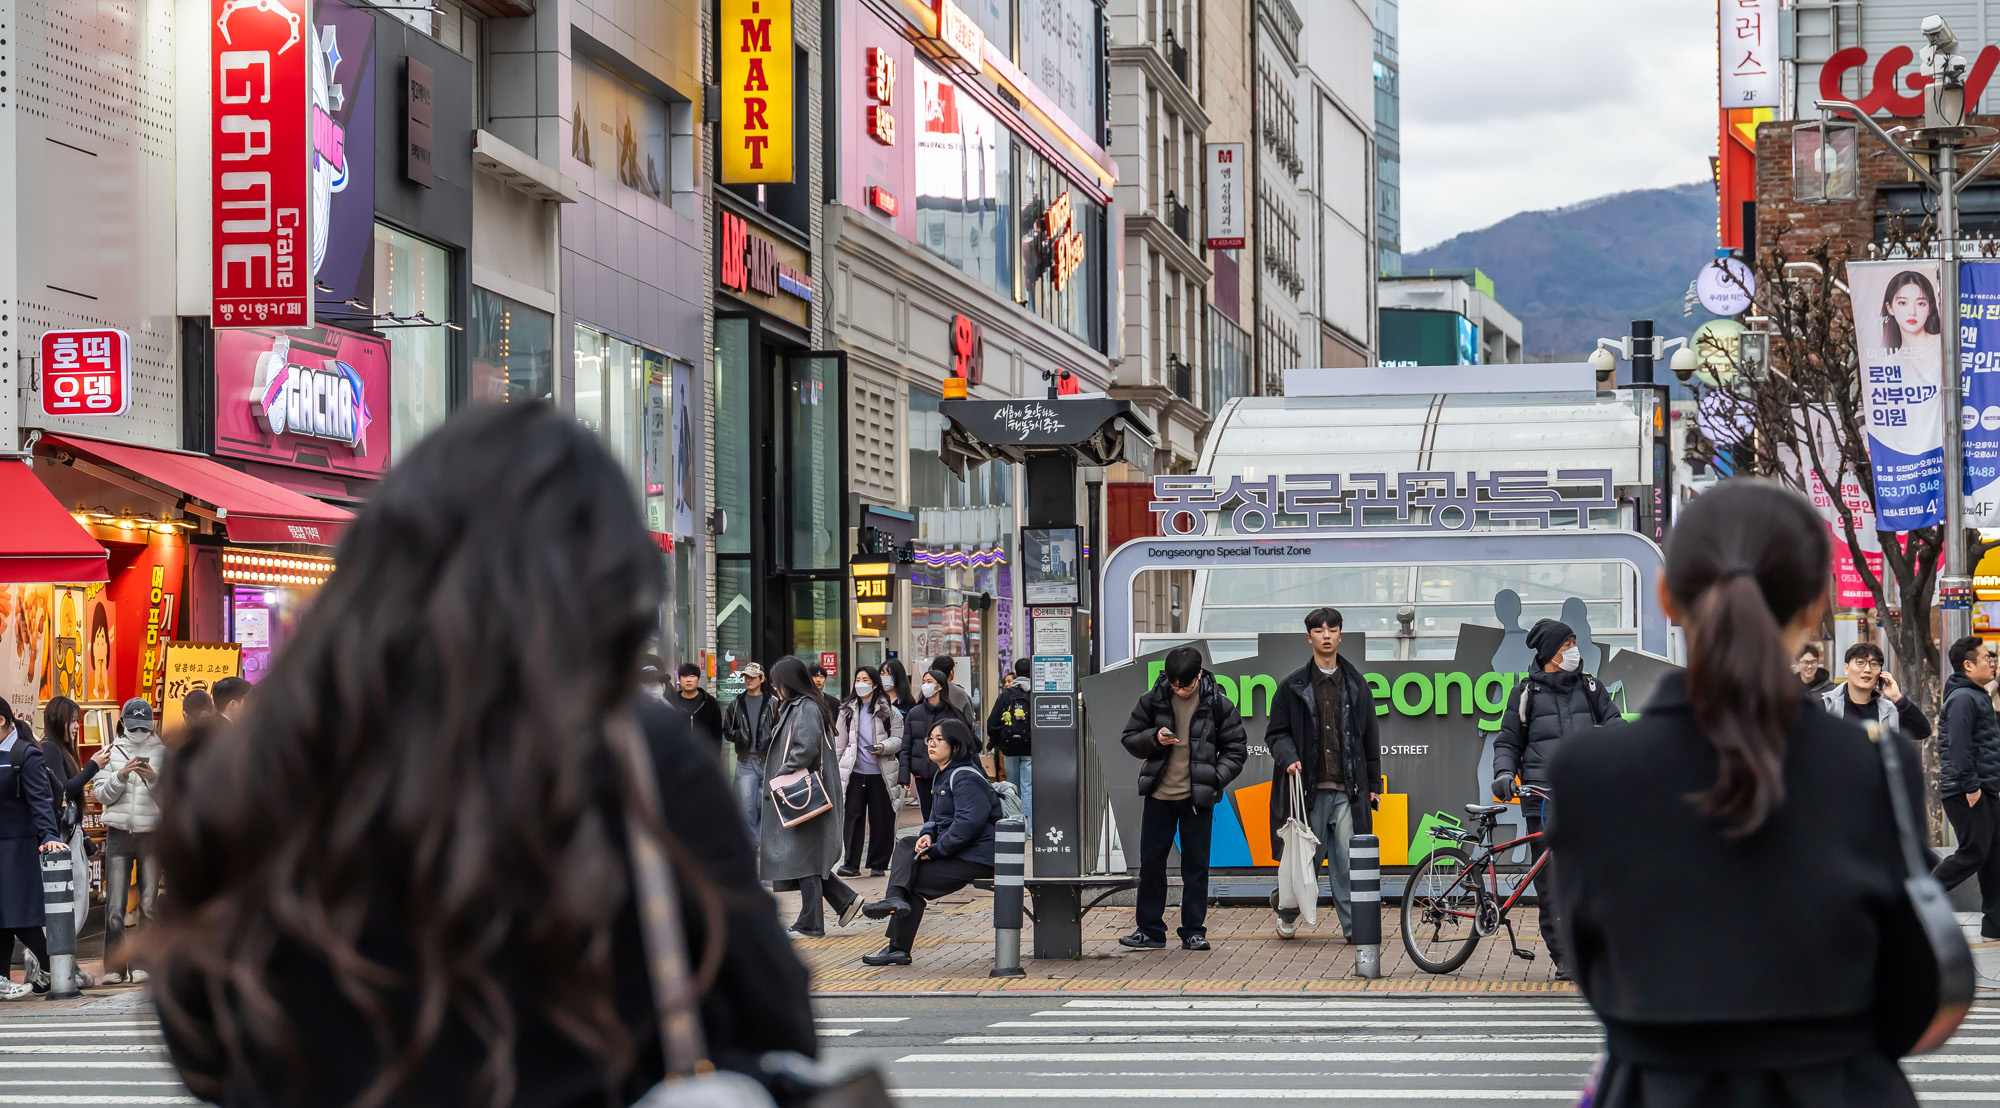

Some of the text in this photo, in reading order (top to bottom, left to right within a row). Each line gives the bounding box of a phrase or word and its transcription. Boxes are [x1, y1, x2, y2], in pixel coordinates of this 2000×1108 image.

[1820, 45, 2000, 118] CGV
[1743, 90, 1757, 101] 2F
[1218, 150, 1232, 163] M
[220, 50, 272, 290] GAME
[277, 208, 299, 288] Crane
[722, 211, 777, 298] ABC-MART
[239, 303, 301, 320] 인형카페
[52, 337, 111, 369] 호떡
[1869, 365, 1902, 383] 로앤
[53, 376, 112, 409] 오뎅
[1871, 385, 1937, 405] 산부인과
[287, 365, 353, 441] GACHA
[1654, 406, 1663, 431] 4
[1872, 408, 1907, 427] 의원
[1149, 468, 1616, 536] 동성로관광특구
[1926, 499, 1938, 514] 4
[1149, 546, 1311, 559] Dongseongno Special Tourist Zone
[857, 580, 887, 597] 커피
[175, 663, 229, 674] 달콤하고 고소한
[1391, 745, 1429, 755] STREET
